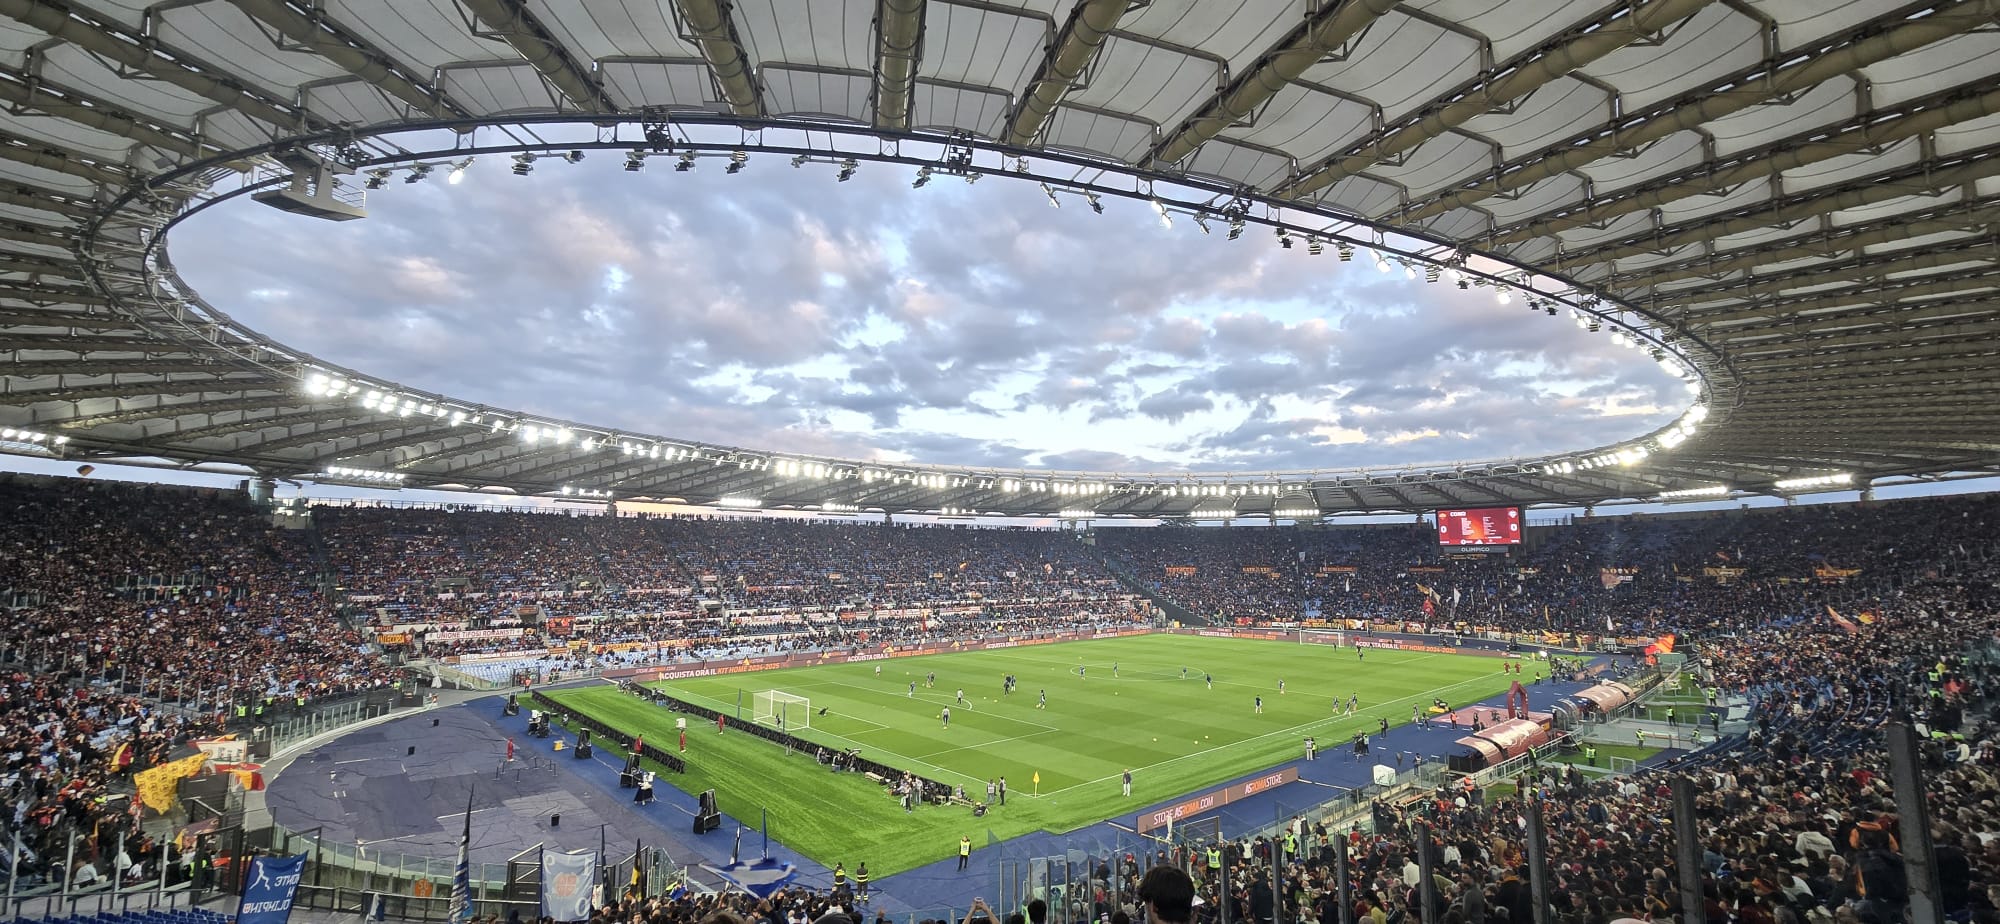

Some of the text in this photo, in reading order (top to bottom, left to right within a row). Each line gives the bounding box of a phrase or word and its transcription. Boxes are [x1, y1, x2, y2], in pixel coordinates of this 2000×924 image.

[1440, 525, 1447, 534] 0
[437, 629, 515, 639] UNIONE TIFOSI ROMANISTI
[660, 669, 694, 680] ACQUISTA
[695, 669, 709, 677] ORA
[730, 665, 747, 673] HOME
[748, 662, 780, 671] 2024-2025
[1153, 796, 1214, 826] STORE.ASROMA.COM
